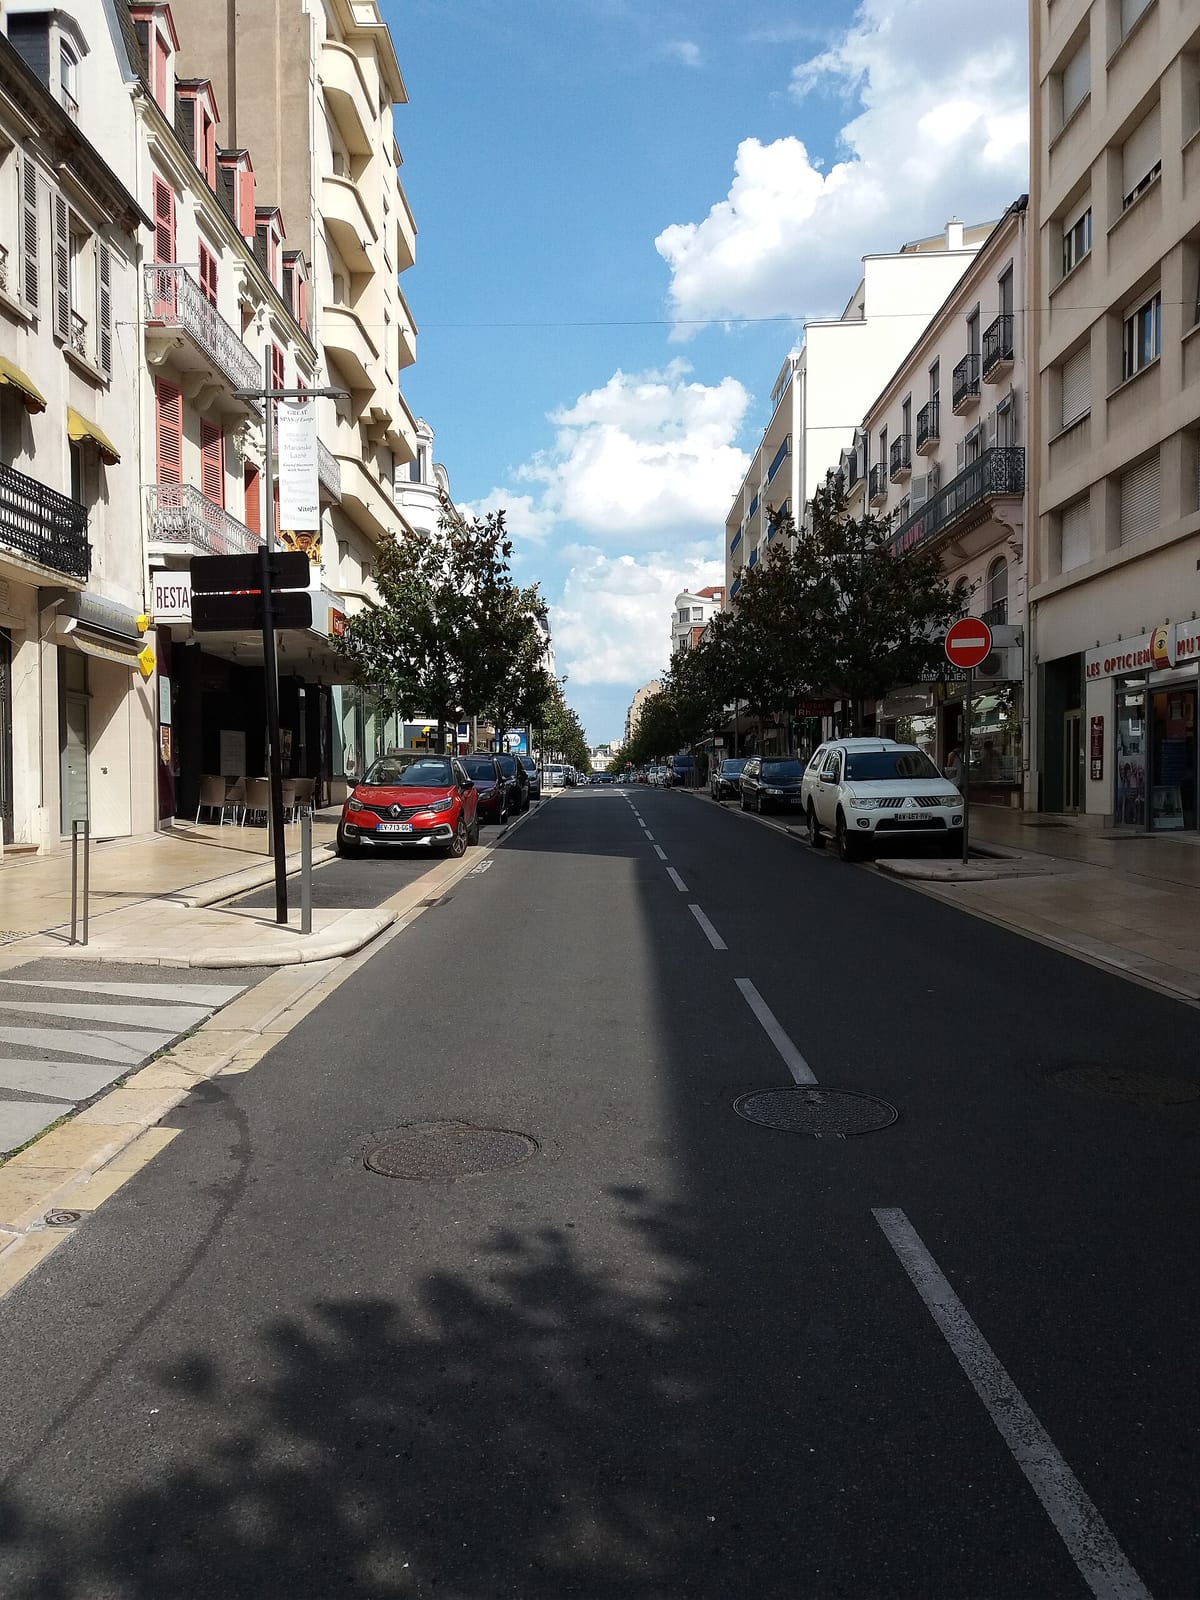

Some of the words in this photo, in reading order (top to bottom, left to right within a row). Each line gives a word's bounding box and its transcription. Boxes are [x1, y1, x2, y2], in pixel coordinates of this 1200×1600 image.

[156, 586, 190, 609] RESTA
[1087, 662, 1100, 677] LES
[1104, 649, 1150, 673] OPTICIEN
